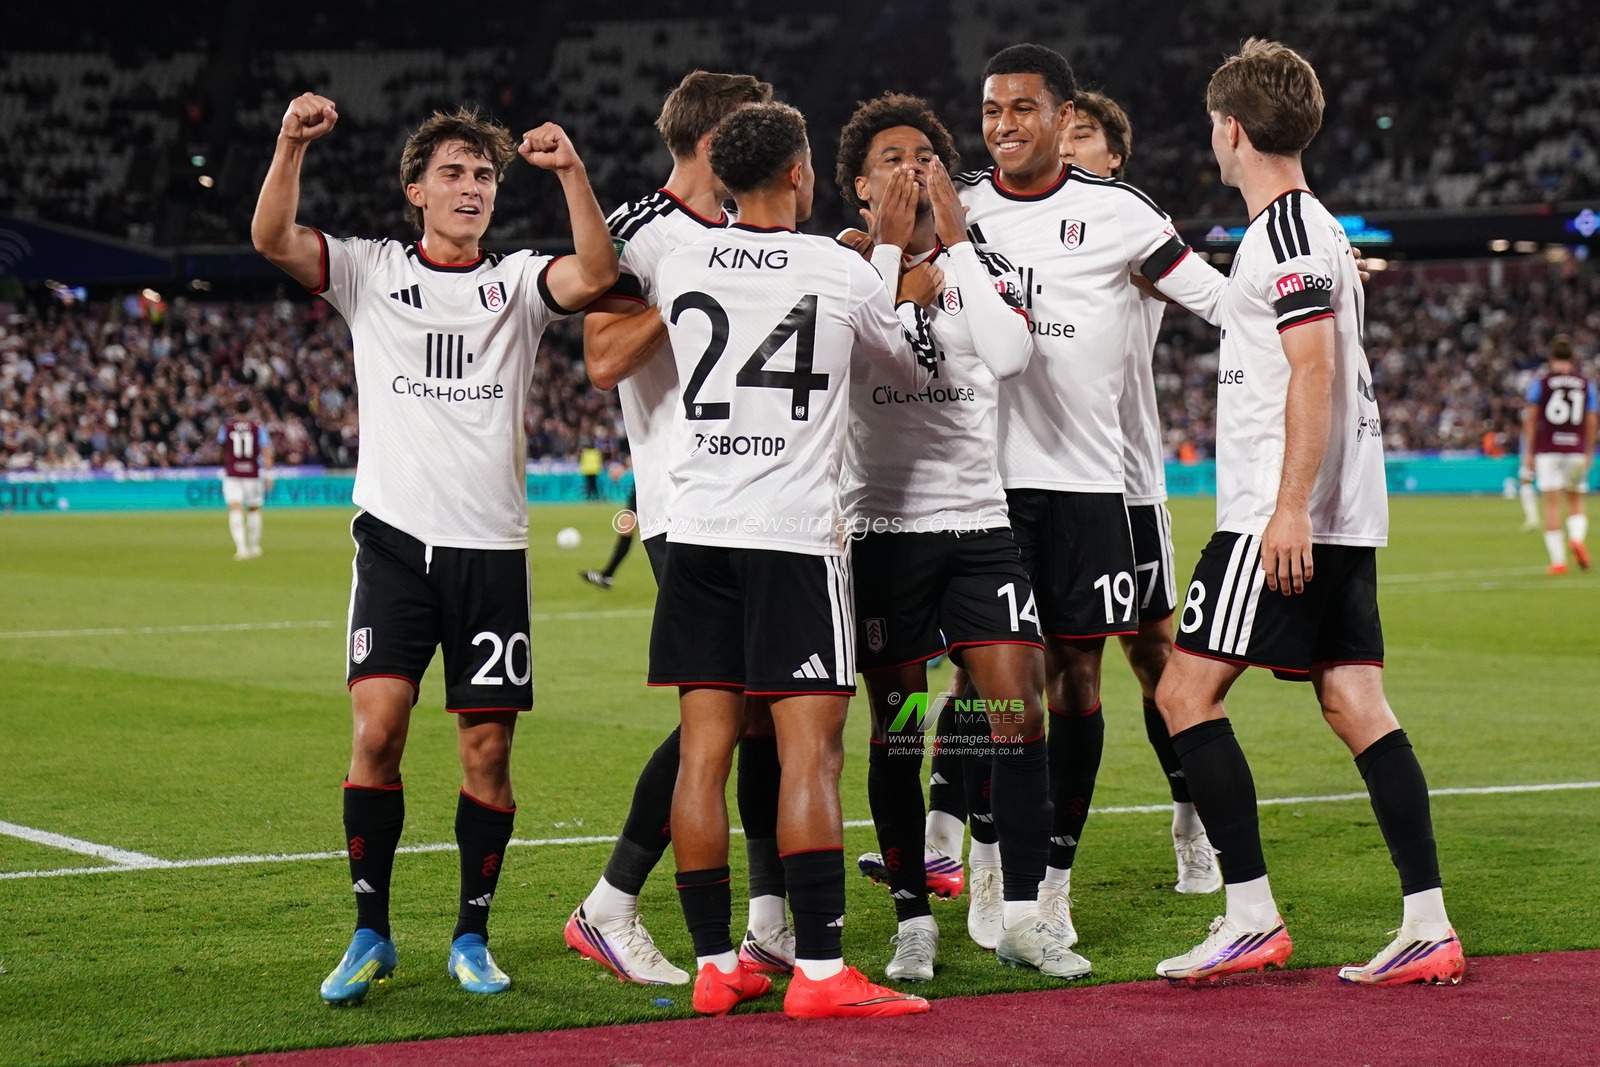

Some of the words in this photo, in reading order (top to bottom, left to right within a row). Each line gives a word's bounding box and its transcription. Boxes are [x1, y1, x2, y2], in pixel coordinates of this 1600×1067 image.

[708, 247, 788, 269] KING
[669, 290, 830, 421] 24
[392, 375, 504, 403] CickHouse
[1545, 388, 1585, 426] 61
[229, 430, 255, 458] 11
[708, 435, 786, 457] SBOTOP
[997, 582, 1042, 640] 14
[1093, 571, 1136, 624] 19
[1179, 580, 1207, 634] 8
[470, 631, 532, 686] 20
